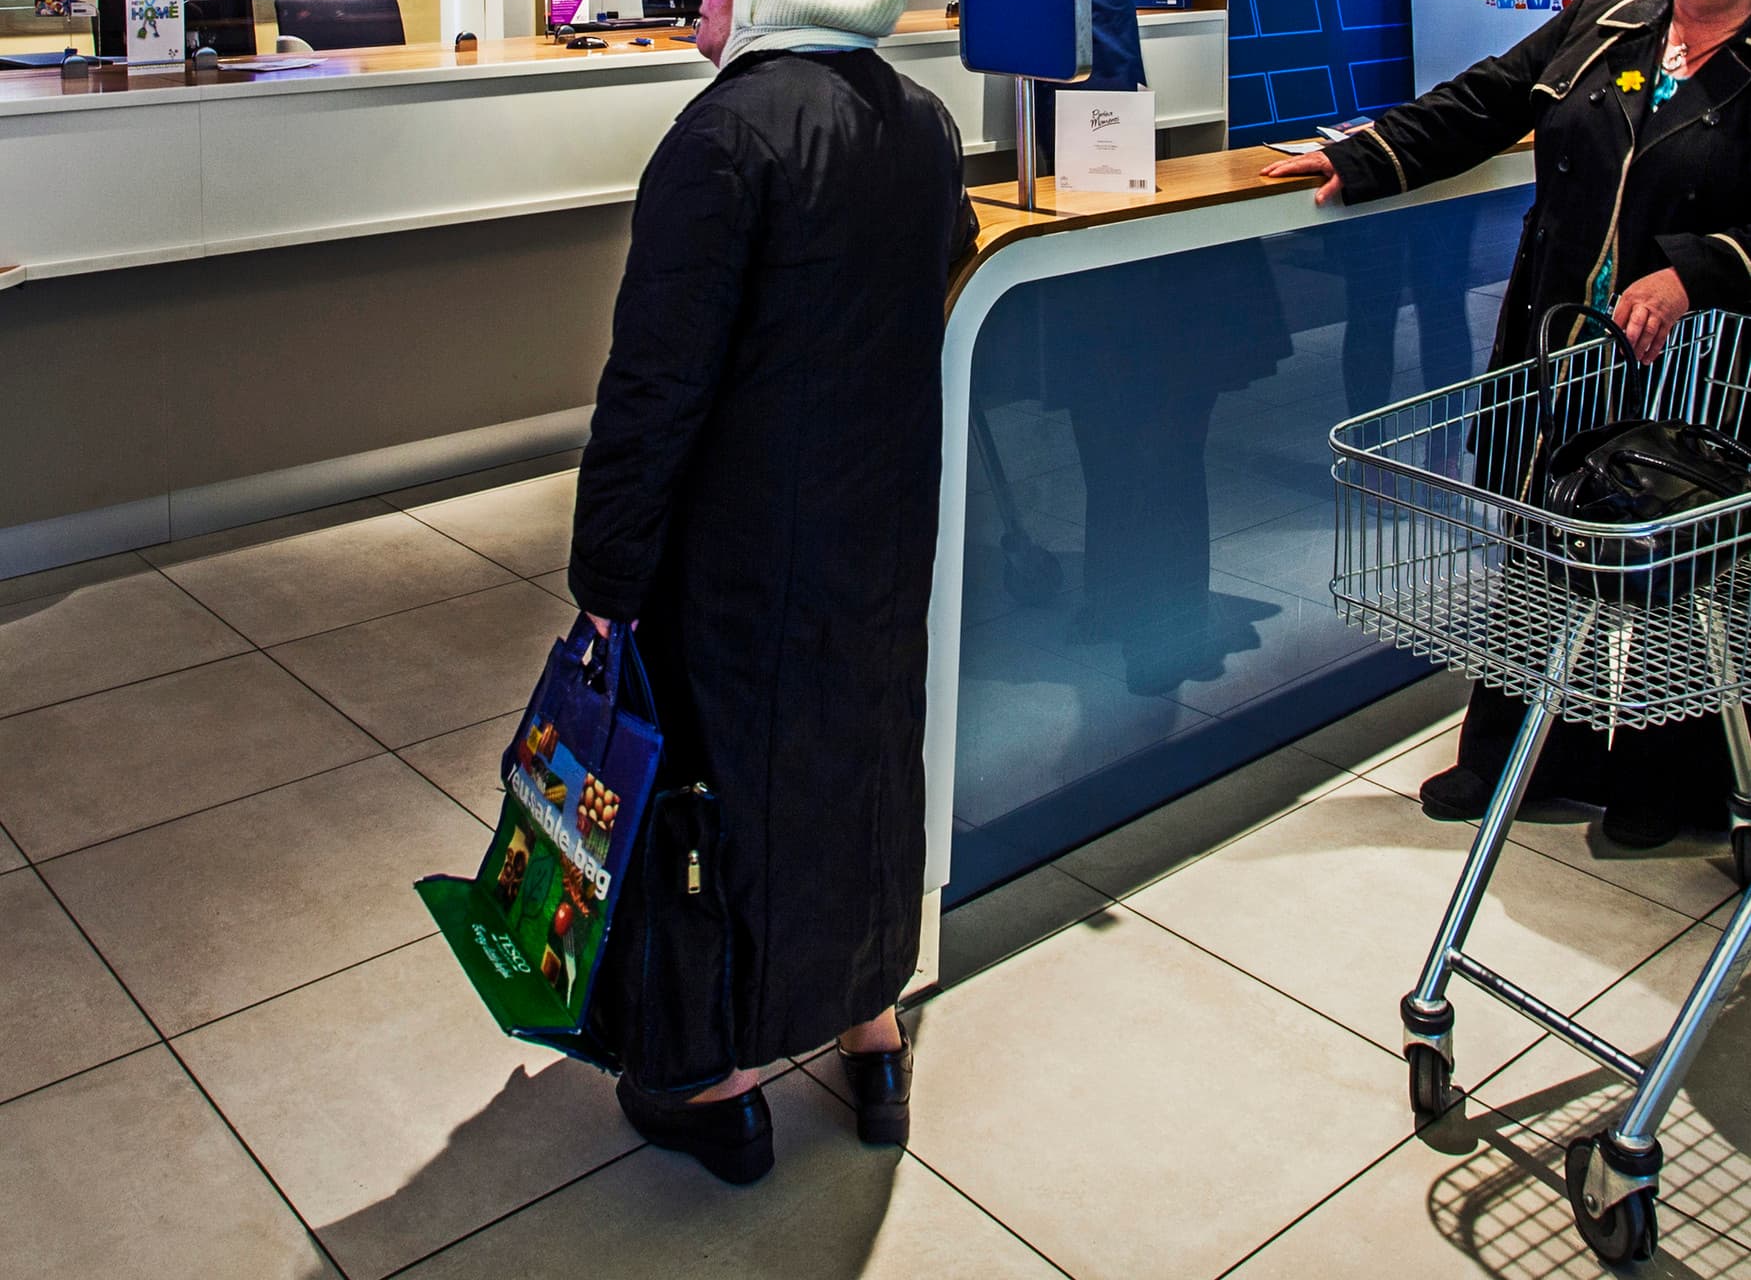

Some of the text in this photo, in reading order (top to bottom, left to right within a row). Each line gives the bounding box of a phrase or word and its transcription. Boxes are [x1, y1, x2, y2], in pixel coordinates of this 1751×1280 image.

[131, 6, 179, 20] HOME
[508, 763, 612, 901] reusable bag
[498, 933, 531, 973] TESCO
